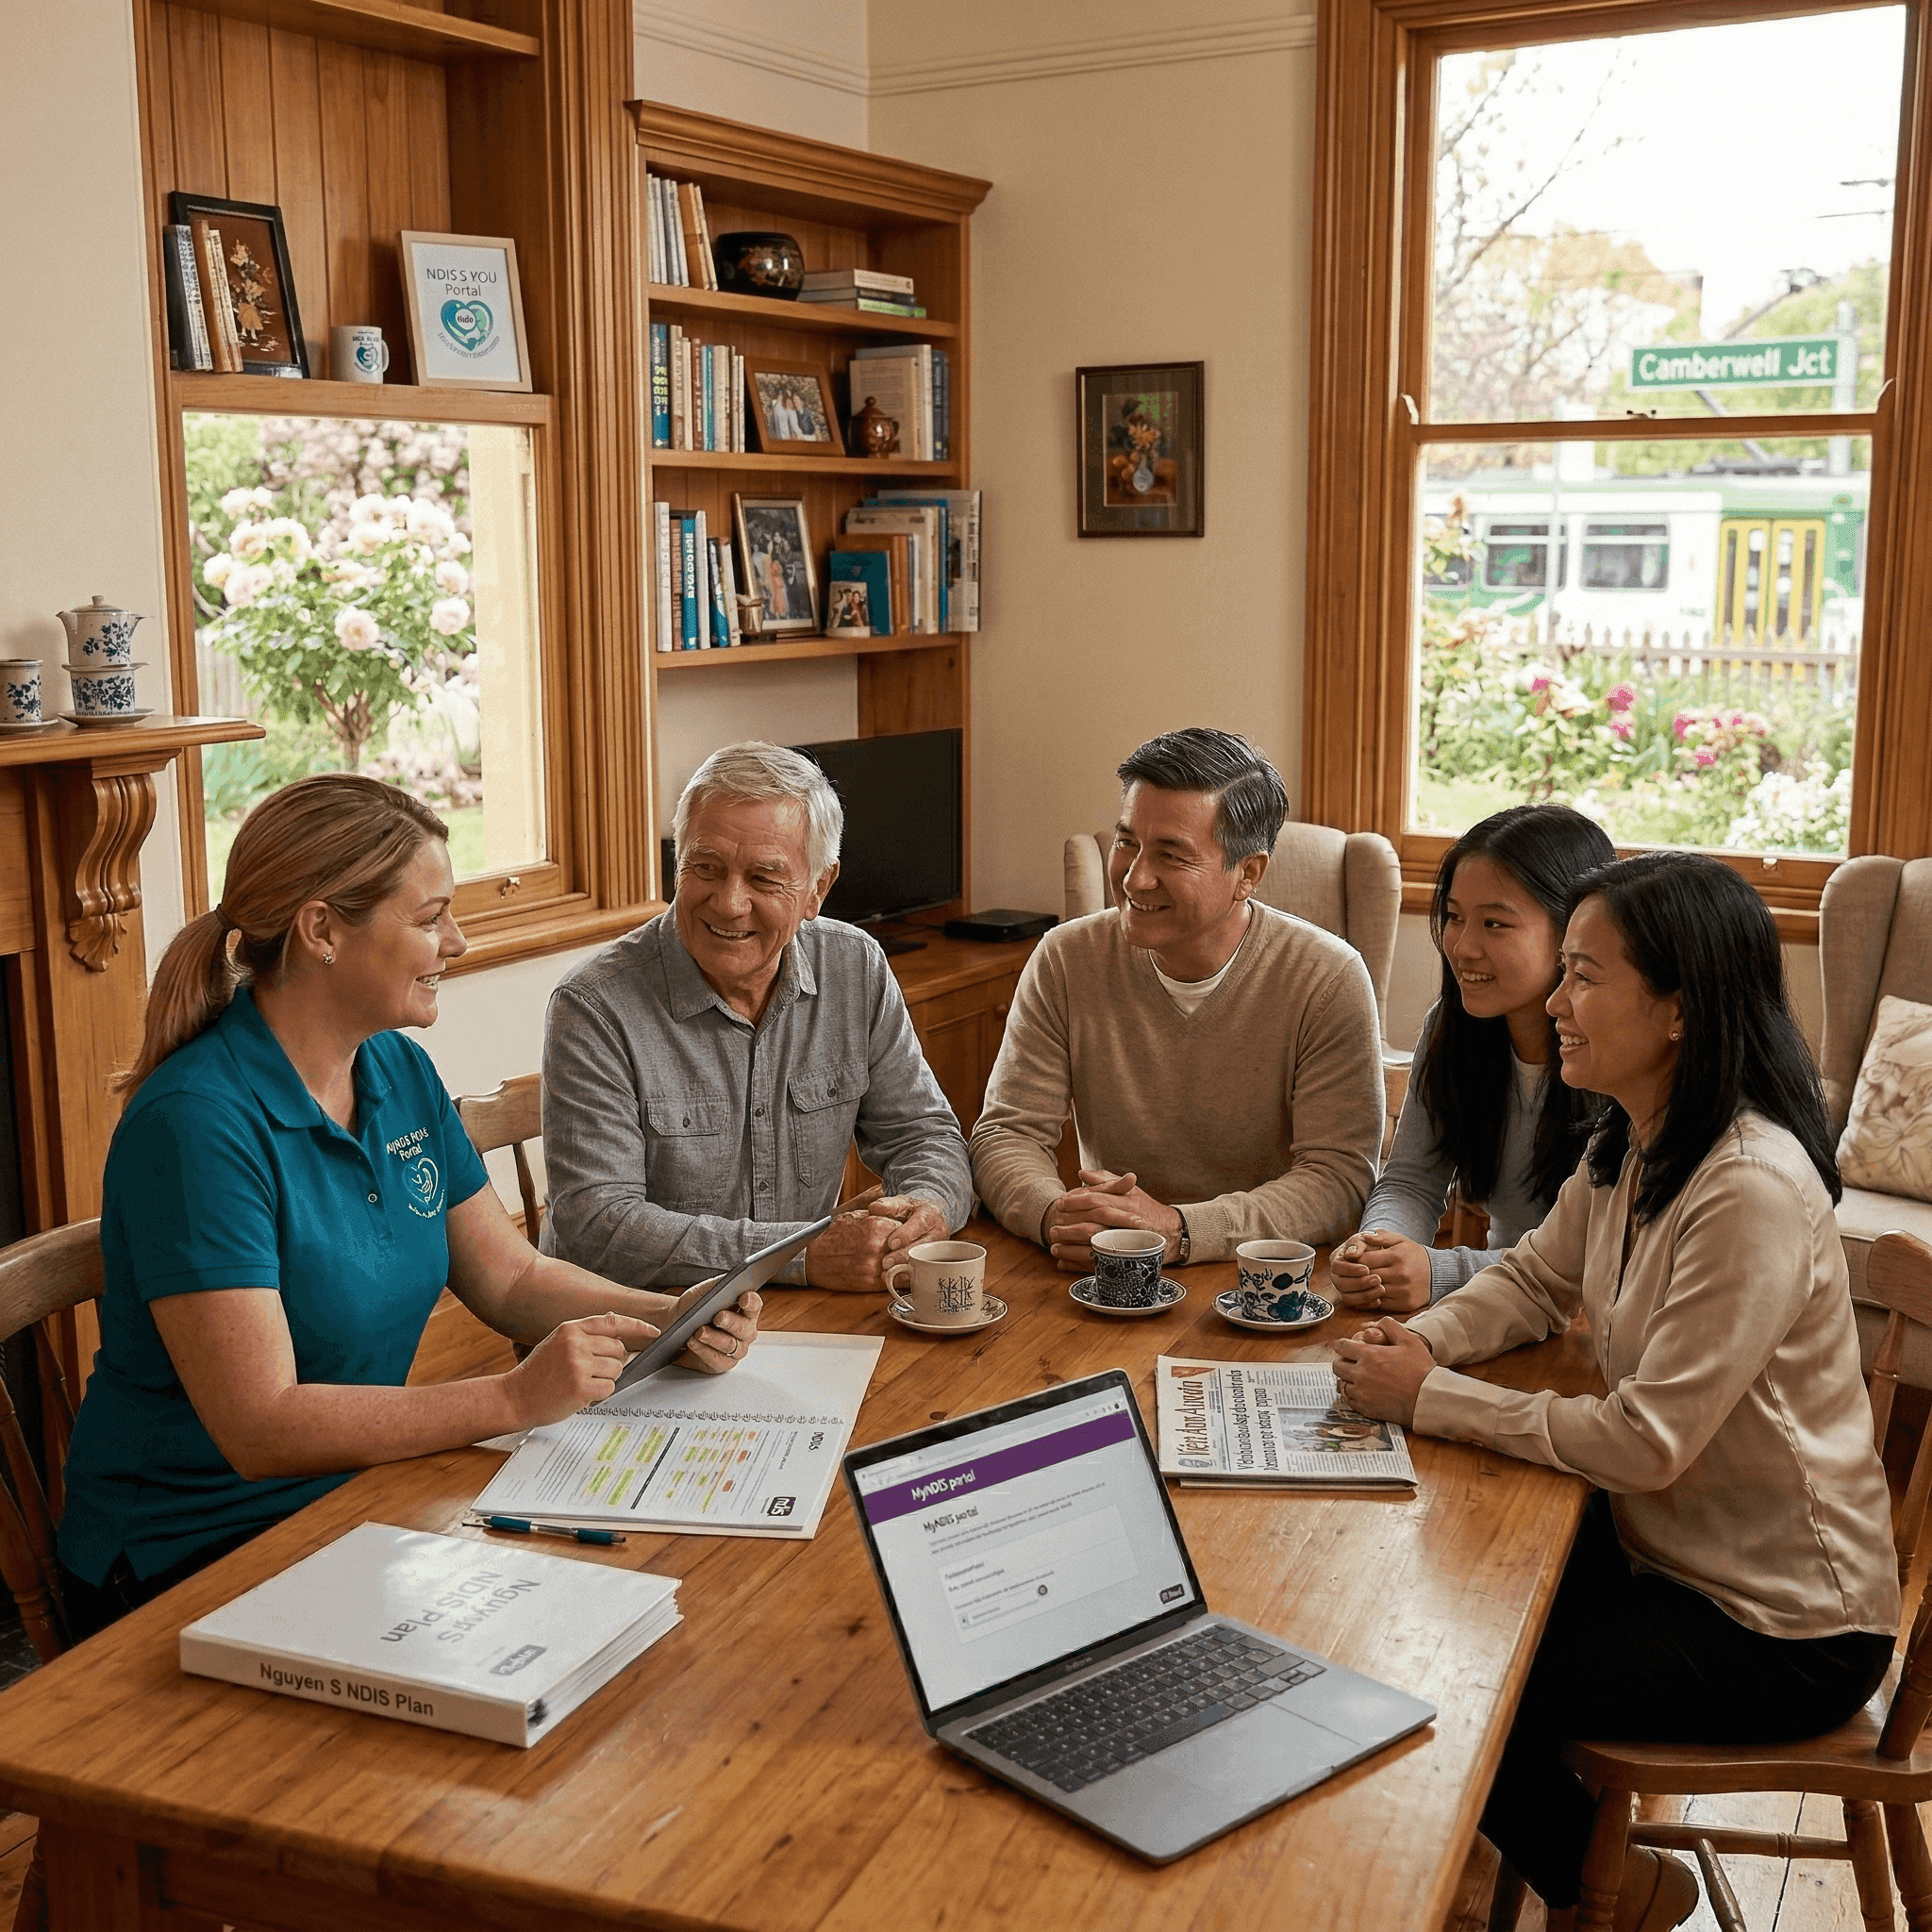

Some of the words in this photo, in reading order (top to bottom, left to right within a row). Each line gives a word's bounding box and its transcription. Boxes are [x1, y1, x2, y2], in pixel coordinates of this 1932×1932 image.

[426, 268, 458, 281] NDIS
[470, 271, 497, 284] YOU
[445, 284, 482, 297] Portal
[1639, 348, 1782, 381] Camberwell
[1787, 345, 1832, 376] Jct
[380, 1609, 445, 1642] Plan
[259, 1662, 325, 1691] Nguyen
[330, 1678, 341, 1695] S
[346, 1682, 391, 1707] NDIS
[395, 1693, 434, 1717] Plan
